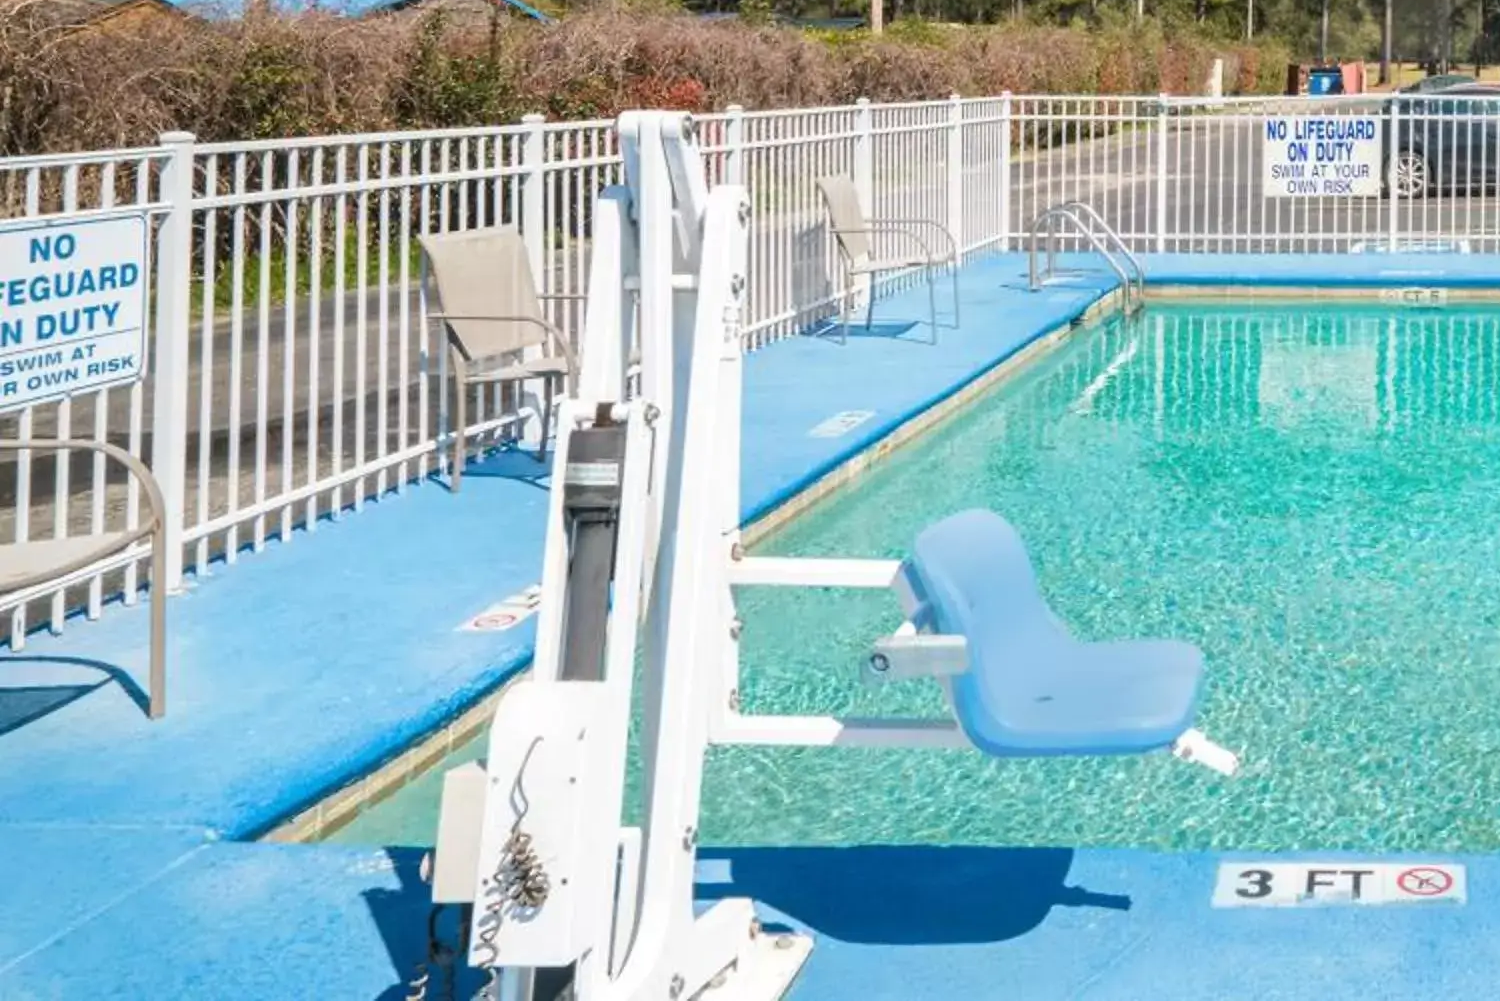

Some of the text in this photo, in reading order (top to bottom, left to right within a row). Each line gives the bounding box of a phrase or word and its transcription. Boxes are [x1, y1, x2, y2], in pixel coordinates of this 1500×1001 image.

[1267, 120, 1375, 140] NO LIFEGUARD
[1287, 142, 1354, 162] ON DUTY
[1271, 164, 1370, 179] SWIM AT YOUR
[1287, 180, 1353, 194] OWN RISK
[29, 233, 76, 263] NO
[0, 262, 139, 306] EGUARD
[36, 301, 121, 341] DUTY
[1, 344, 97, 376] SWIM AT
[27, 367, 79, 391] OWN
[87, 355, 135, 376] RISK
[1235, 869, 1374, 900] 3 FT
